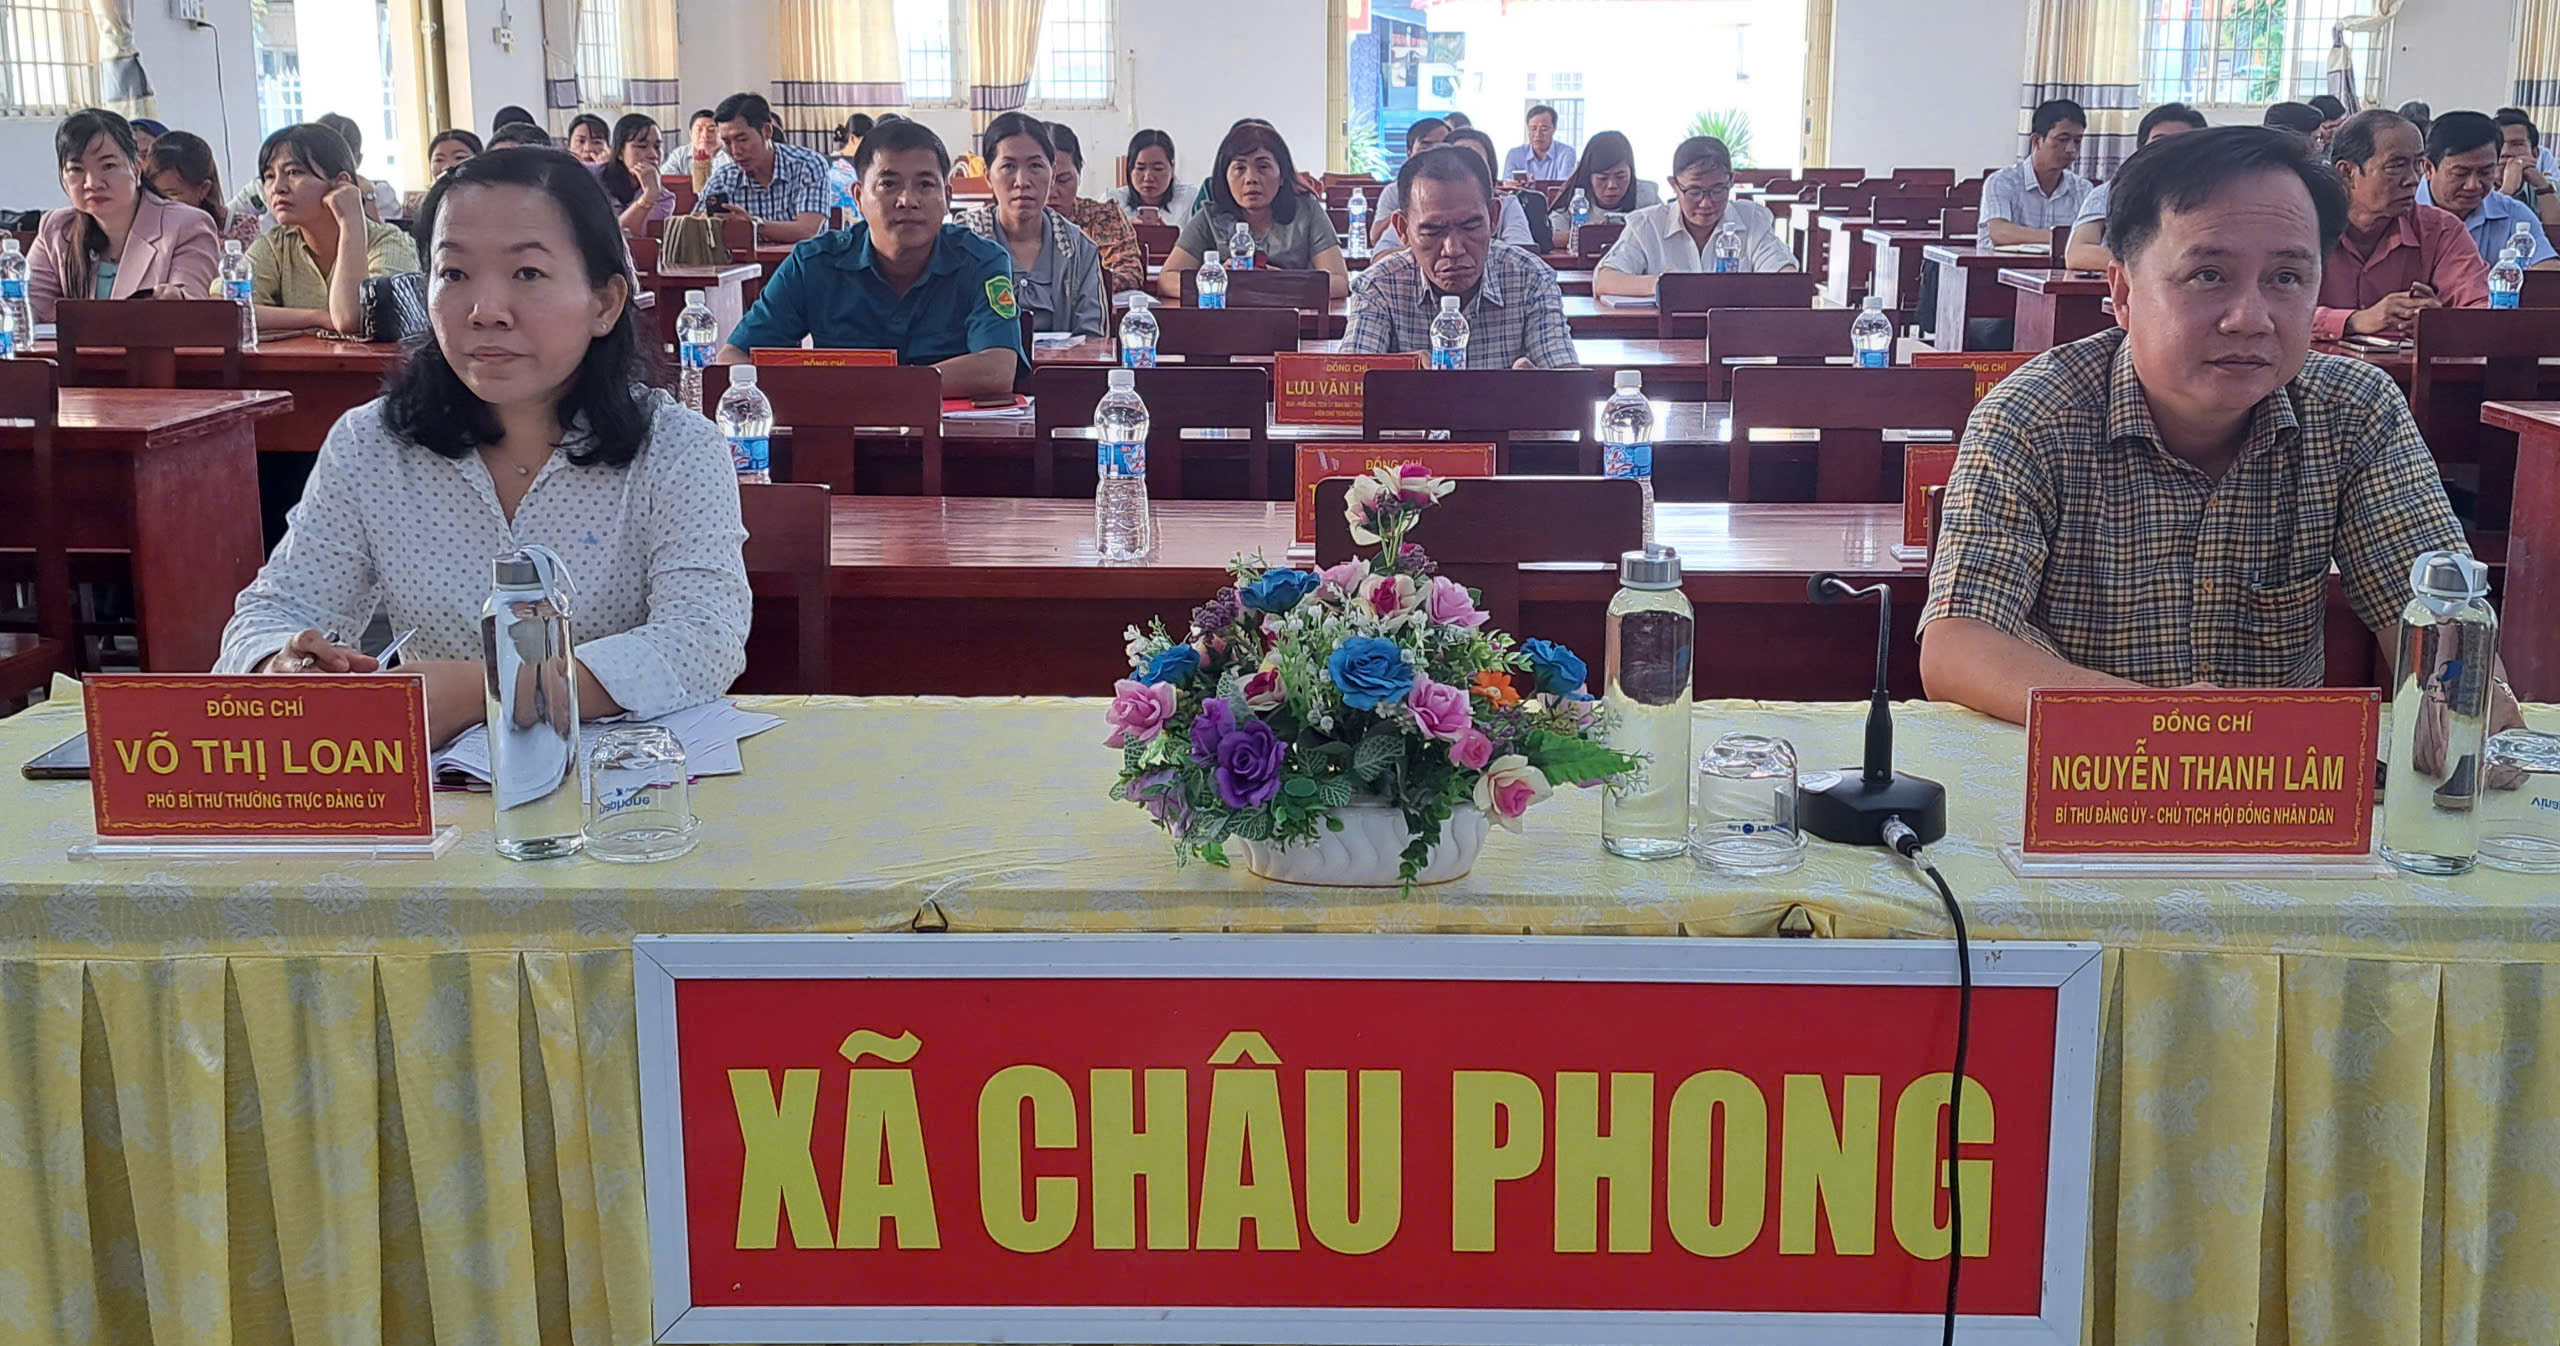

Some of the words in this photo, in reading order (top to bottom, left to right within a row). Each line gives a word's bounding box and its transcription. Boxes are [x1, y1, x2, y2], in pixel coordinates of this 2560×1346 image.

[1991, 361, 2007, 372] CHÍ
[1285, 379, 1315, 395] LƯU
[1319, 377, 1350, 396] VĂN
[206, 693, 265, 717] ĐỒNG
[271, 695, 304, 717] CHÍ
[2152, 707, 2212, 732] ĐỒNG
[2217, 710, 2254, 732] CHÍ
[113, 730, 179, 774] VÕ
[191, 739, 267, 781] THỊ
[282, 739, 404, 774] LOAN
[2051, 738, 2171, 791] NGUYỄN
[2179, 755, 2276, 791] THANH
[2284, 746, 2345, 791] LÂM
[179, 789, 193, 808] BÍ
[195, 791, 224, 808] THƯ
[224, 789, 282, 809] THƯỜNG
[285, 791, 322, 811] TRỰC
[326, 787, 364, 809] ĐẢNG
[367, 787, 386, 809] ỦY
[2055, 801, 2069, 824] BÍ
[2070, 804, 2095, 824] THƯ
[2096, 800, 2129, 825] ĐẢNG
[2131, 800, 2148, 824] ỦY
[2157, 800, 2182, 825] CHỦ
[2184, 806, 2211, 828] TỊCH
[2214, 802, 2235, 828] HỘI
[2237, 800, 2271, 825] ĐỒNG
[2273, 802, 2307, 824] NHÂN
[2309, 802, 2335, 824] DÂN
[727, 1029, 942, 1252] XÃ
[976, 1031, 1404, 1256] CHÂU
[1452, 1066, 1998, 1260] PHONG
